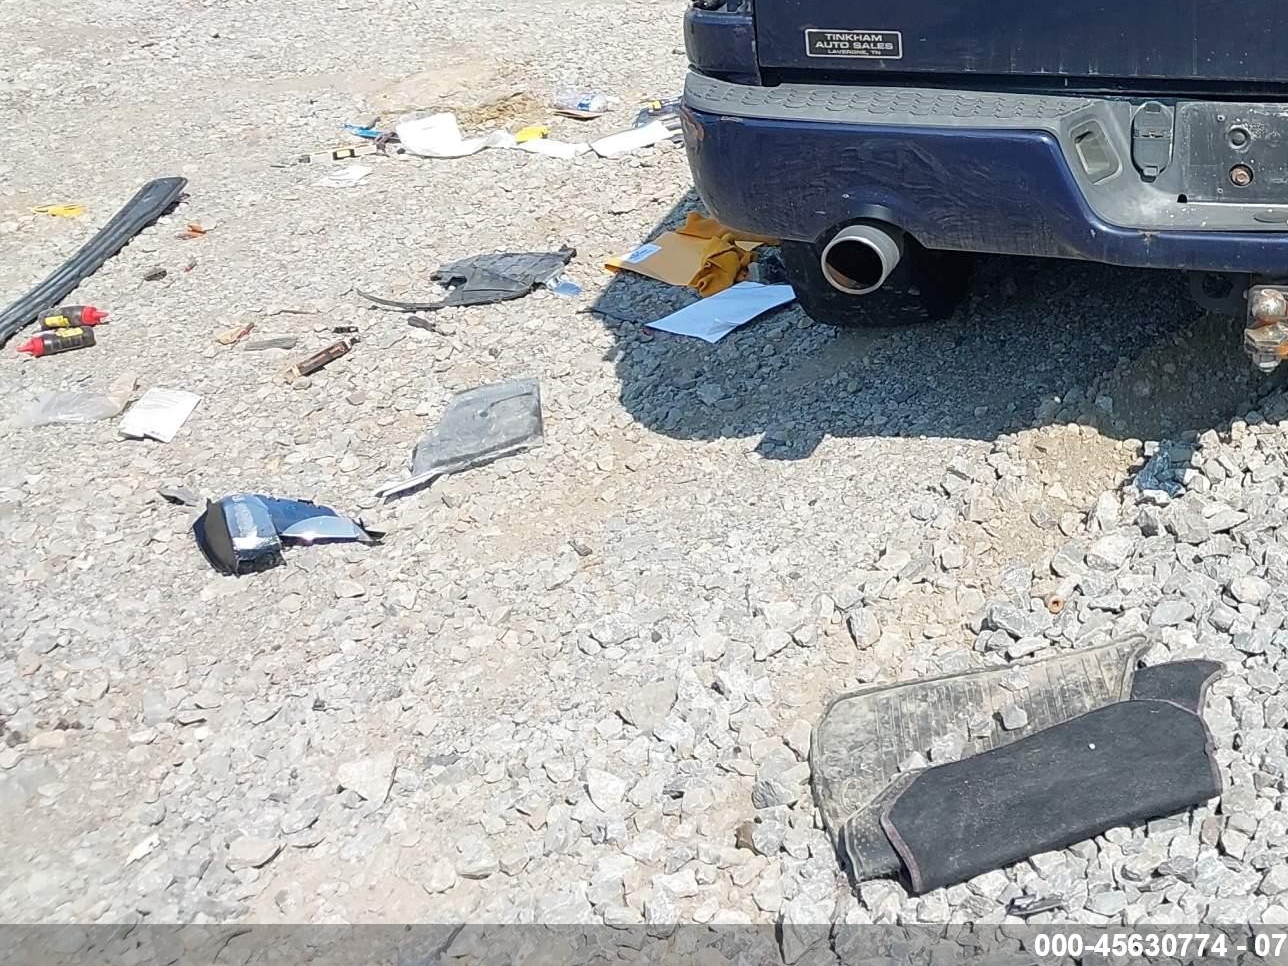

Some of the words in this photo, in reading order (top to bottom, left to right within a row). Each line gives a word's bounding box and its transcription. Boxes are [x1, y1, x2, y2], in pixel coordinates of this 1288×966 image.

[825, 33, 882, 42] TINKHAM
[815, 41, 849, 49] AUTO
[852, 42, 894, 50] SALES
